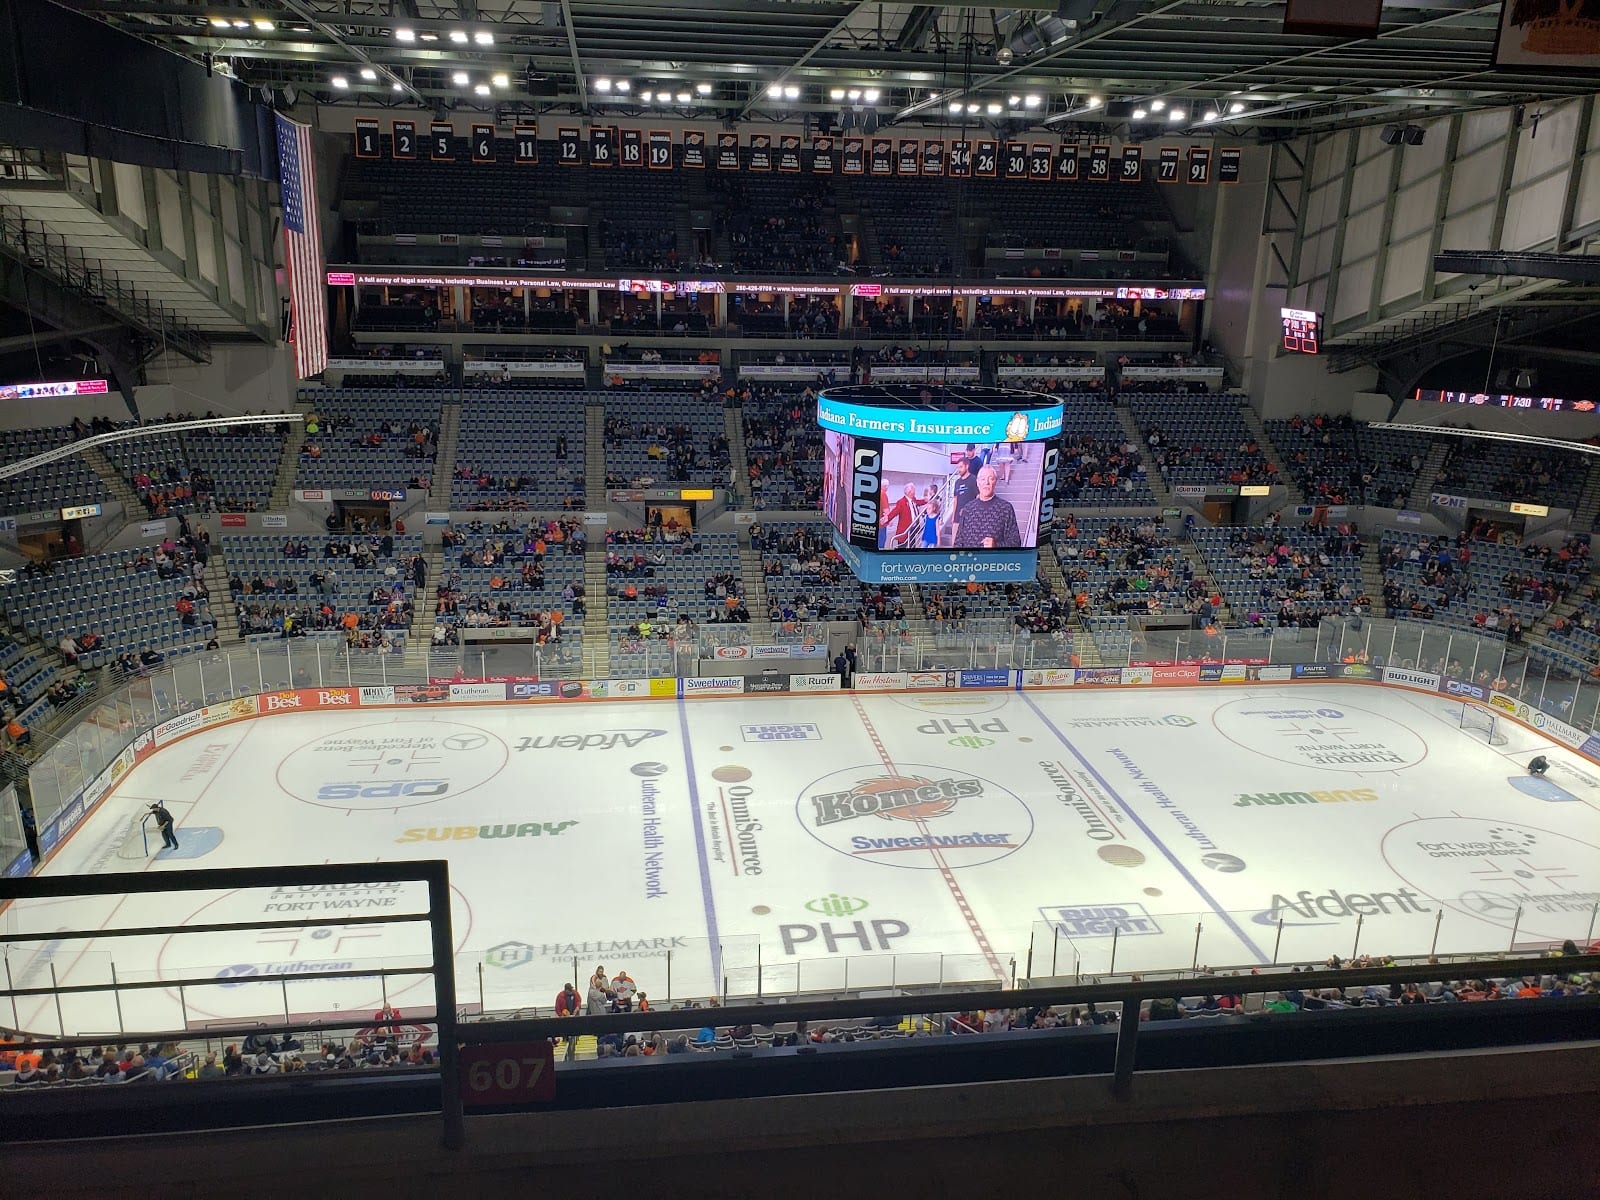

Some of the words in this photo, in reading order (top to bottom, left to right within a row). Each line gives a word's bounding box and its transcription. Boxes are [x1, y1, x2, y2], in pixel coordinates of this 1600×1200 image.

[363, 135, 372, 152] 1
[400, 136, 409, 153] 2
[438, 138, 447, 154] 5
[480, 140, 488, 156] 6
[519, 141, 533, 158] 11
[561, 142, 577, 159] 12
[594, 144, 608, 160] 16
[624, 144, 639, 161] 18
[651, 148, 668, 164] 19
[977, 155, 994, 171] 26
[1008, 157, 1024, 173] 30
[1031, 157, 1049, 174] 33
[1059, 159, 1075, 175] 40
[1091, 160, 1106, 175] 58
[1123, 160, 1138, 176] 59
[1161, 162, 1176, 177] 77
[1191, 165, 1206, 180] 91
[445, 278, 475, 286] including:
[900, 288, 914, 296] array
[1513, 397, 1532, 408] 7:30
[820, 404, 846, 425] Indiana
[849, 412, 906, 433] Farmers
[909, 418, 991, 436] Insurance
[852, 448, 880, 524] OPS
[1040, 448, 1059, 523] OPS
[881, 562, 902, 573] fort
[904, 564, 942, 575] wayne
[944, 562, 1021, 572] ORTHOPEDICS
[754, 647, 789, 655] Sweetwater
[808, 677, 835, 685] Ruoff
[858, 675, 871, 685] Tim
[872, 675, 901, 685] Hortons
[1154, 670, 1176, 678] Great
[1178, 670, 1196, 679] Clips
[1388, 672, 1408, 681] BUD
[1409, 674, 1437, 686] LIGHT
[514, 684, 552, 695] OPS
[687, 679, 741, 688] Sweetwater
[1446, 680, 1484, 698] OPS
[267, 695, 303, 710] Best
[318, 691, 352, 705] Best
[156, 713, 201, 736] BFGoodrich
[747, 724, 814, 733] LIGHT
[916, 717, 1010, 735] PHP
[1546, 719, 1583, 742] HALLMARK
[324, 738, 375, 748] Wayne
[382, 737, 417, 746] Fort
[514, 732, 650, 752] Afdent
[757, 731, 807, 740] BUD
[313, 742, 436, 754] Mercedes-Benz
[1105, 747, 1147, 780] Network
[1310, 754, 1408, 764] PURDUE
[317, 781, 449, 800] OPS
[641, 779, 661, 816] Lutheran
[1138, 778, 1177, 809] Health
[1233, 788, 1379, 807] SUBWAY
[811, 778, 984, 827] Komets
[1038, 760, 1115, 841] OmniSource
[394, 820, 579, 844] SUBWAY
[642, 817, 665, 850] Health
[728, 786, 763, 876] OmniSource
[1169, 809, 1218, 851] Lutheran
[851, 832, 1011, 850] Sweetwater
[1416, 840, 1457, 851] fort
[1459, 838, 1521, 851] wayne
[1428, 848, 1531, 858] ORTHOPEDICS
[644, 851, 668, 900] Network
[263, 901, 322, 914] FORT
[323, 897, 396, 910] WAYNE
[1268, 887, 1432, 921] Afdent
[1057, 907, 1131, 920] BUD
[1058, 917, 1151, 937] LIGHT
[779, 919, 910, 955] PHP
[540, 936, 689, 956] HALLMARK
[551, 955, 587, 964] HOME
[588, 950, 676, 961] MORTGAGE
[264, 962, 353, 974] Lutheran
[469, 1057, 547, 1092] 607
